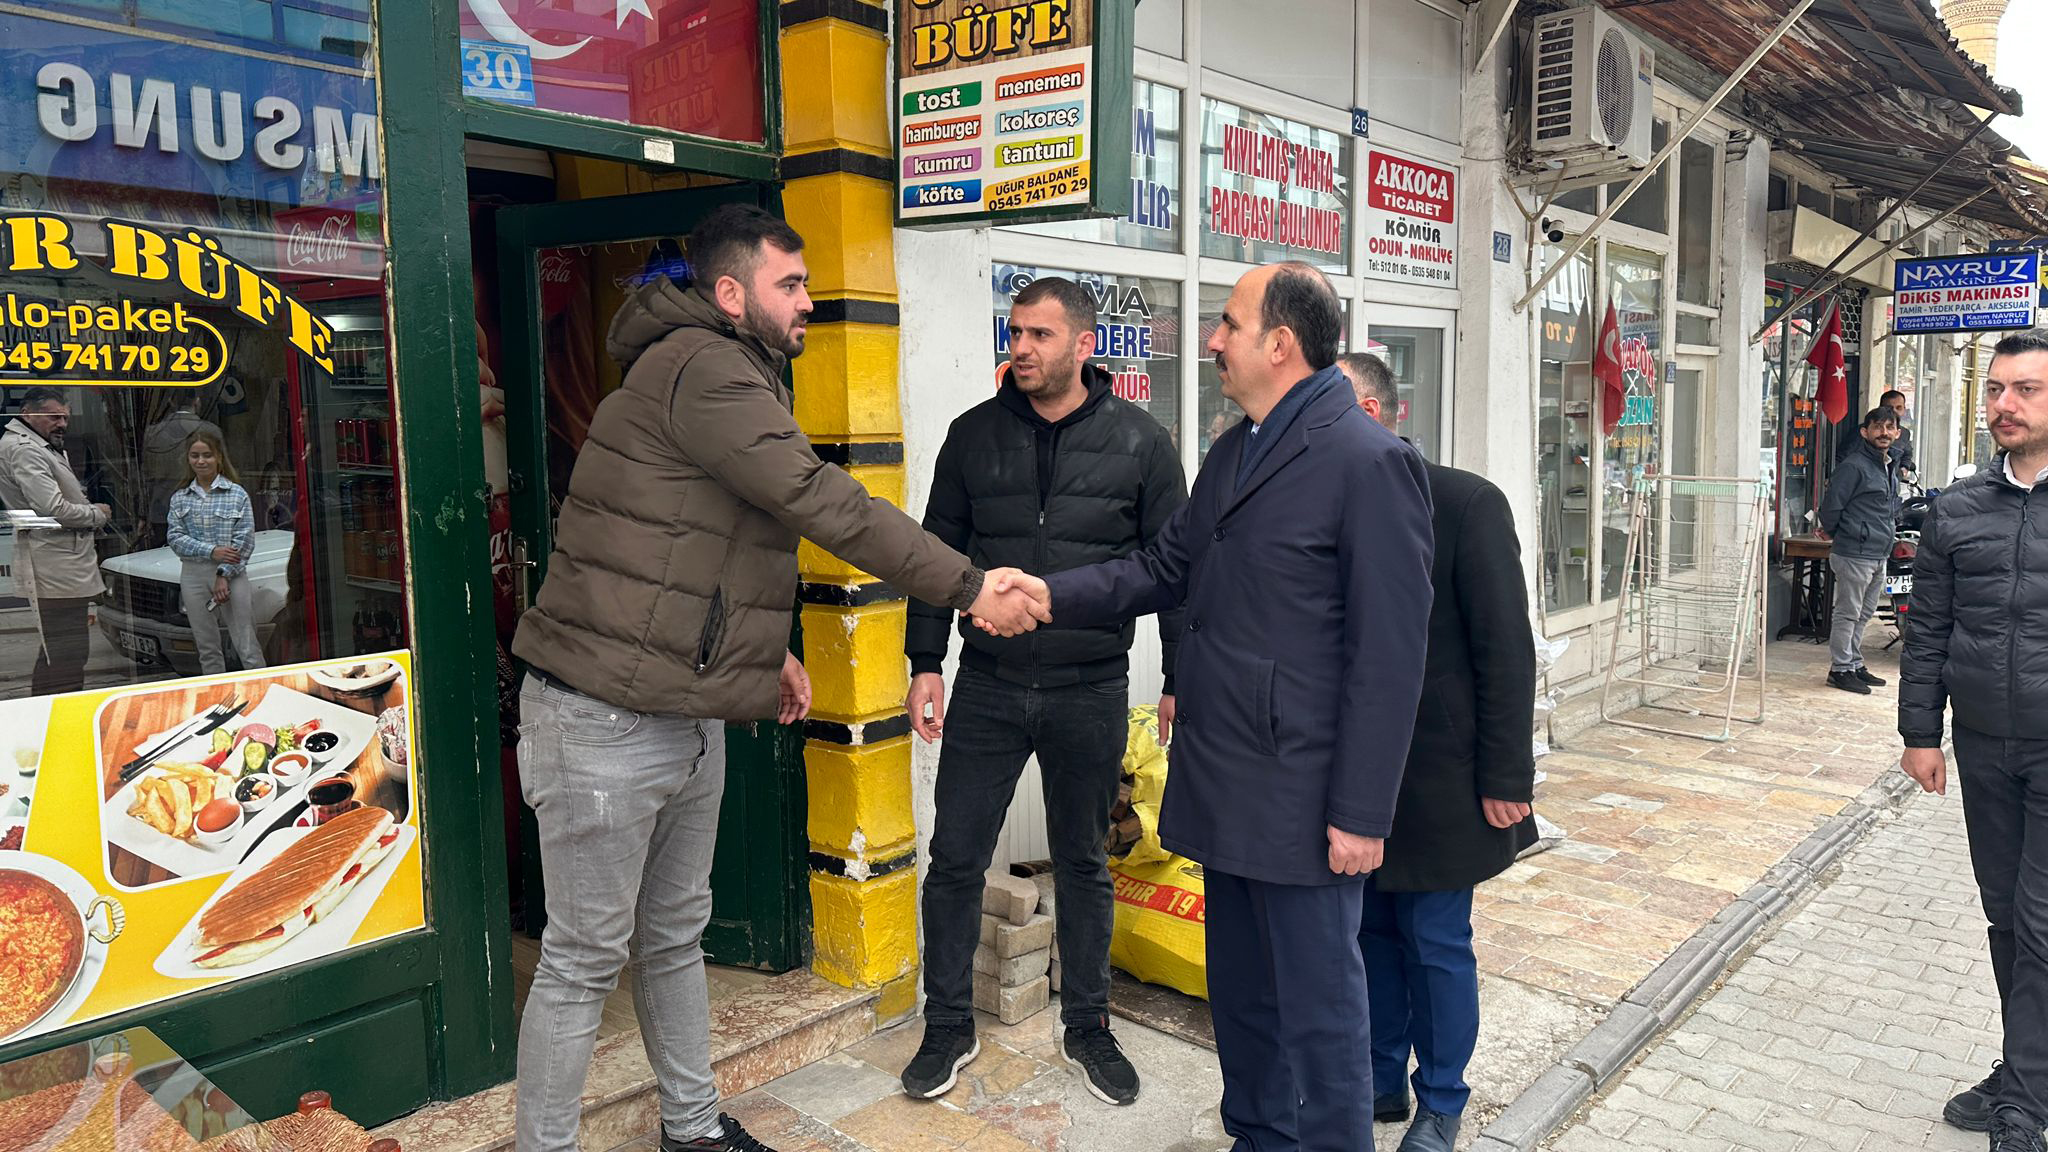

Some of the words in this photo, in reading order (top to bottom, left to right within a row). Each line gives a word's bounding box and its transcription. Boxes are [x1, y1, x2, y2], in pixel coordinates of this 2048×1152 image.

[913, 0, 1072, 70] BÜFE
[465, 49, 521, 90] 30
[998, 71, 1082, 98] menemen
[917, 87, 961, 112] tost
[905, 118, 980, 144] hamburger
[999, 107, 1080, 133] kokoreç
[1354, 115, 1368, 133] 26
[1002, 137, 1075, 165] tantuni
[1222, 123, 1291, 193] KIYILMIŞ
[1294, 144, 1334, 194] TAHTA
[914, 155, 973, 175] kumru
[995, 179, 1025, 197] UĞUR
[1028, 166, 1080, 190] BALDANE
[1374, 159, 1449, 201] AKKOCA
[919, 185, 965, 205] köfte
[988, 193, 1022, 211] 0545
[1025, 188, 1046, 204] 741
[1050, 184, 1067, 197] 70
[1071, 177, 1088, 193] 29
[1382, 191, 1442, 217] TİCARET
[1210, 186, 1276, 248] PARÇASI
[1278, 200, 1341, 254] BULUNUR
[1385, 217, 1441, 243] KÖMÜR
[1368, 237, 1403, 257] ODUN
[1410, 243, 1453, 265] NAKLİYE
[1496, 237, 1509, 256] 28
[1368, 259, 1379, 271] Tel:
[1380, 261, 1391, 273] 512
[1392, 263, 1399, 273] 01
[1400, 264, 1407, 275] 05
[1902, 259, 2029, 287] NAVRUZ
[107, 222, 335, 376] BÜFE
[1928, 303, 1954, 313] YEDEK
[1956, 302, 1981, 314] PARÇA
[1988, 301, 2030, 311] AKSESUAR
[0, 294, 188, 337] lo-paket
[1924, 315, 1957, 323] NAVRUZ
[1991, 311, 2026, 320] NAVRUZ
[62, 343, 113, 371] 741
[120, 345, 161, 371] 70
[169, 345, 210, 373] 29
[1886, 576, 1900, 585] 07
